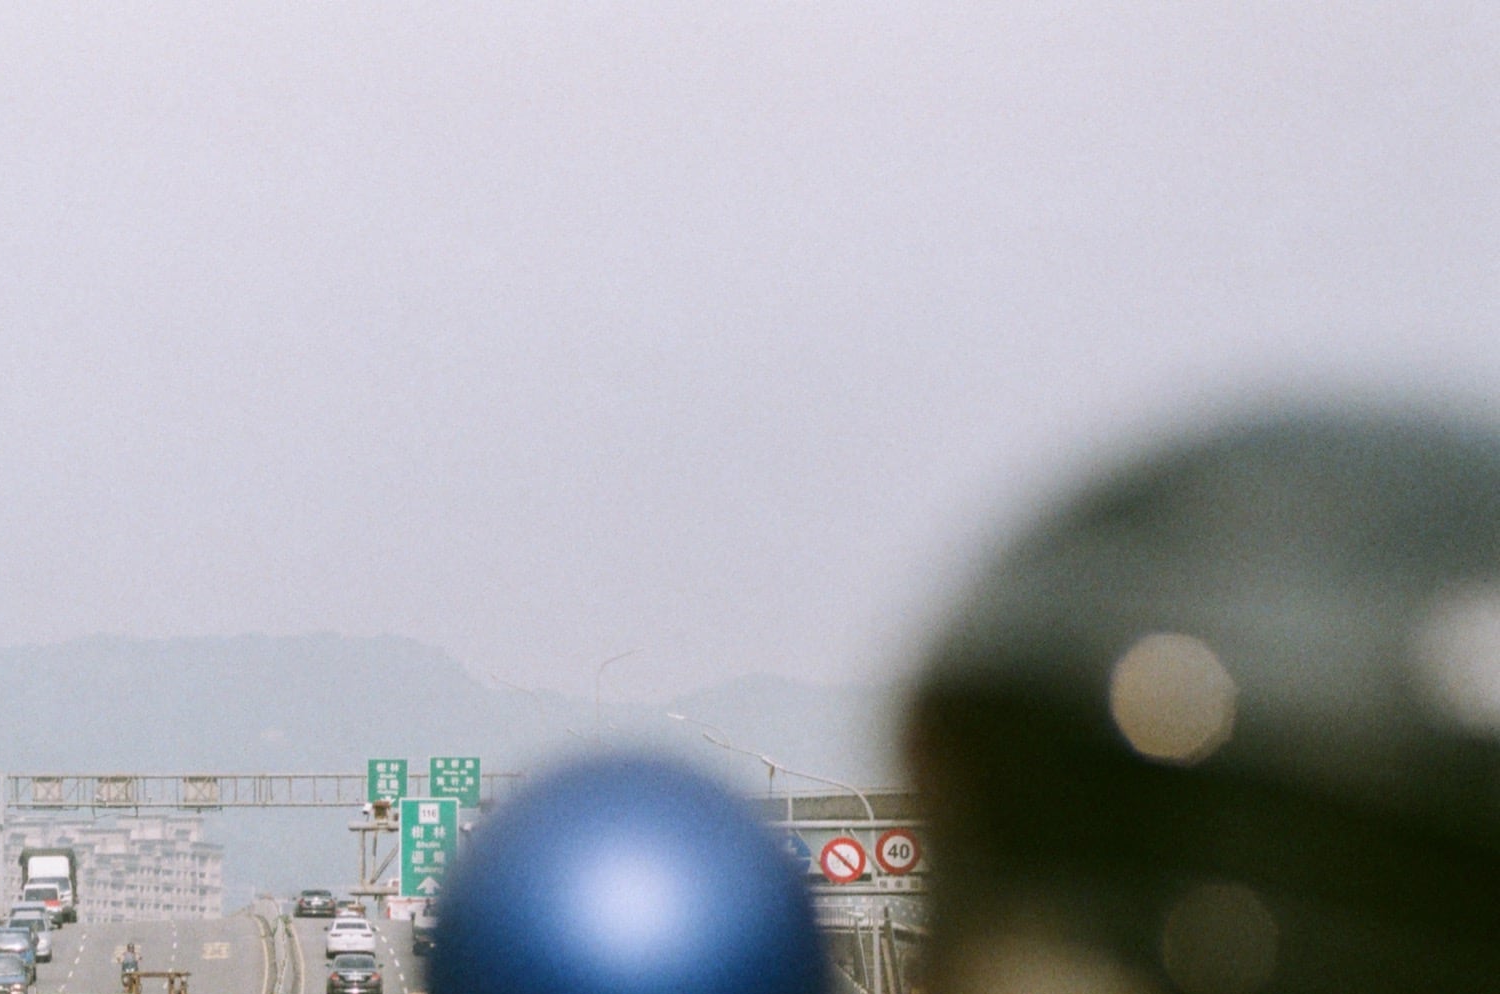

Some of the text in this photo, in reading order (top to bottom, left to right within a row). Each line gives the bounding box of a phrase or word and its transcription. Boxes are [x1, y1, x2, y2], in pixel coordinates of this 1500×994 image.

[422, 809, 437, 818] 116
[412, 825, 446, 839] 樹林
[416, 841, 441, 849] Shulin
[888, 843, 910, 860] 40
